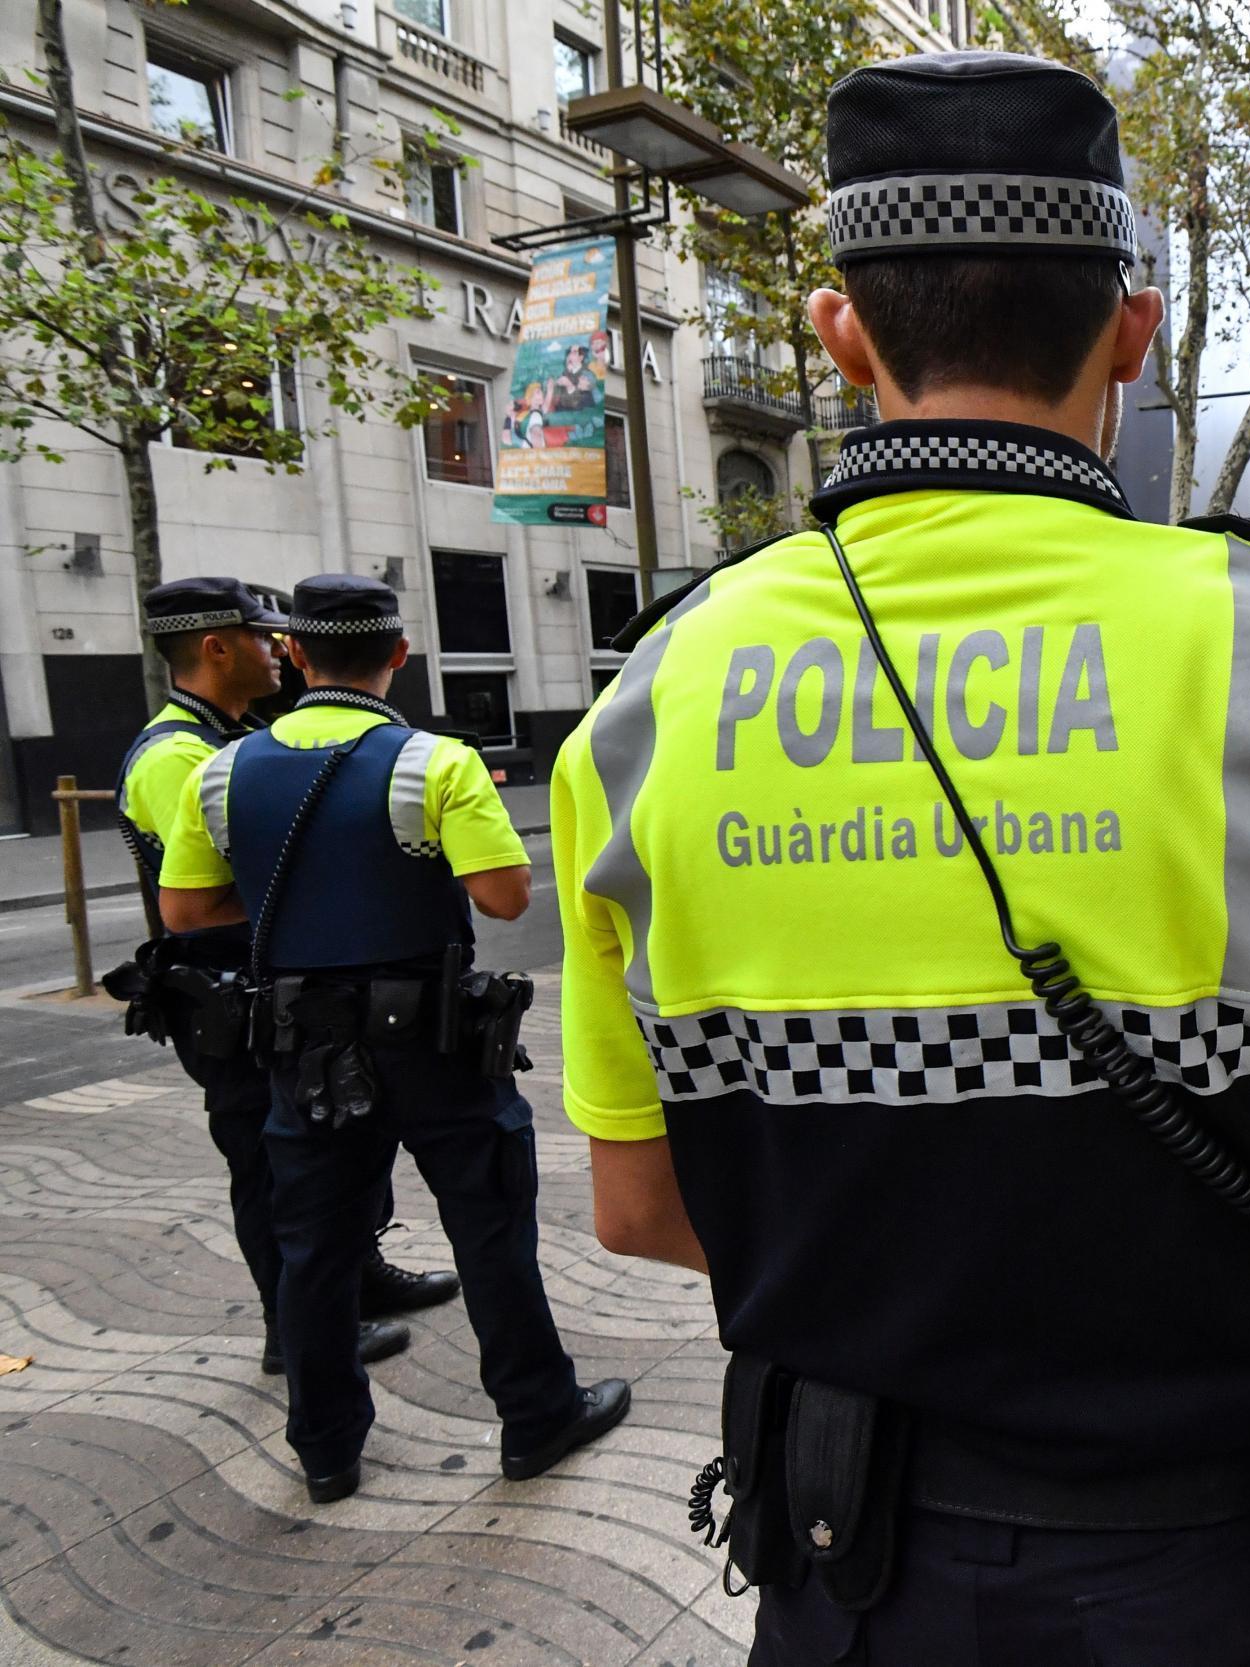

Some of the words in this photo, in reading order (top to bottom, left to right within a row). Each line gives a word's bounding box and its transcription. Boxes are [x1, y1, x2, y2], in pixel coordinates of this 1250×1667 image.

[52, 628, 75, 640] 128
[202, 611, 237, 621] POLICIA
[716, 624, 1119, 771] POLICIA
[717, 806, 918, 868] Guàrdia
